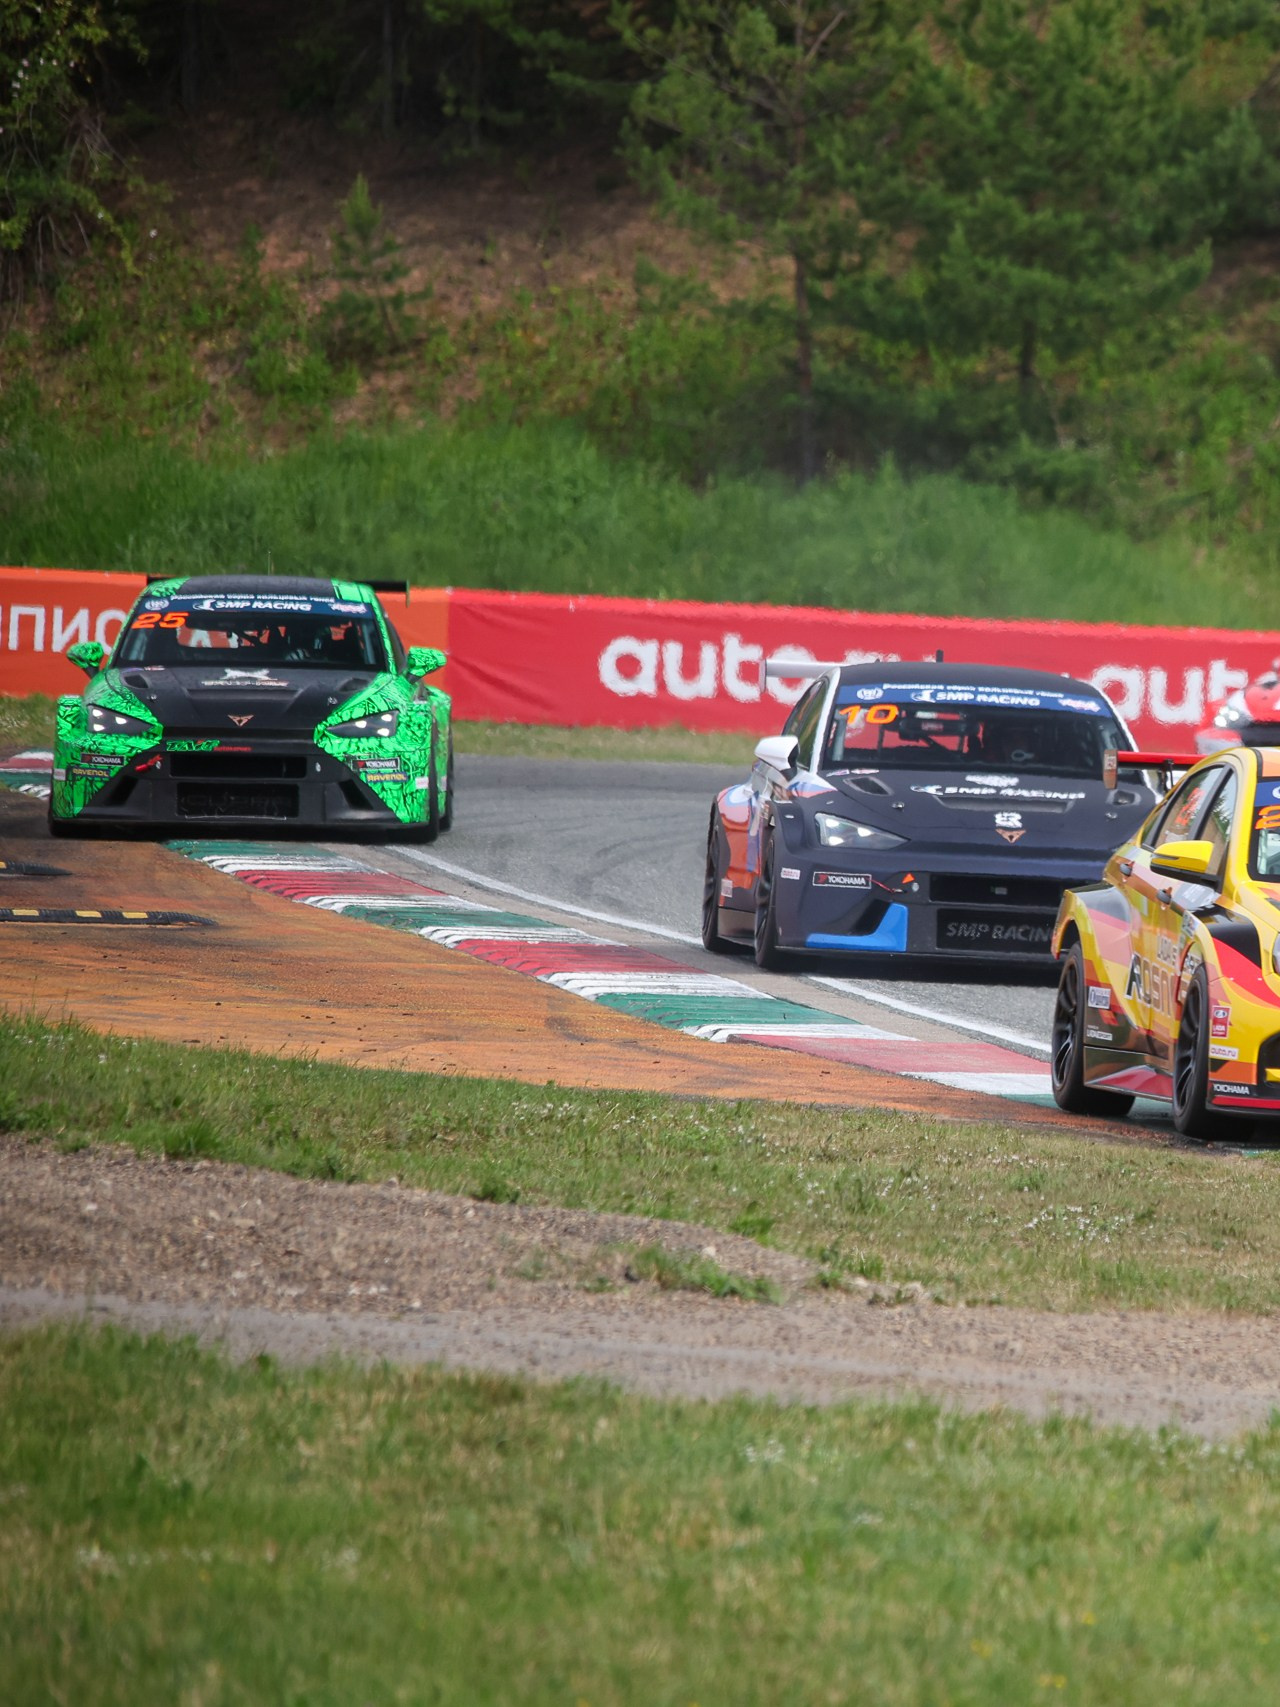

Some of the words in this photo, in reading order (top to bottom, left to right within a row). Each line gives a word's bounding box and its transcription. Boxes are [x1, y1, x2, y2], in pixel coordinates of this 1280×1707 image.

[216, 600, 250, 609] SMP
[252, 601, 312, 611] RACING
[131, 612, 189, 629] 25
[0, 604, 130, 656] ПИО
[936, 691, 974, 701] SMP
[976, 694, 1041, 706] RACING
[838, 704, 898, 725] 10
[827, 875, 866, 885] YOKOHAMA
[946, 922, 991, 939] SMP
[992, 924, 1054, 943] RACIN
[1213, 1083, 1250, 1095] YOKOHAMA
